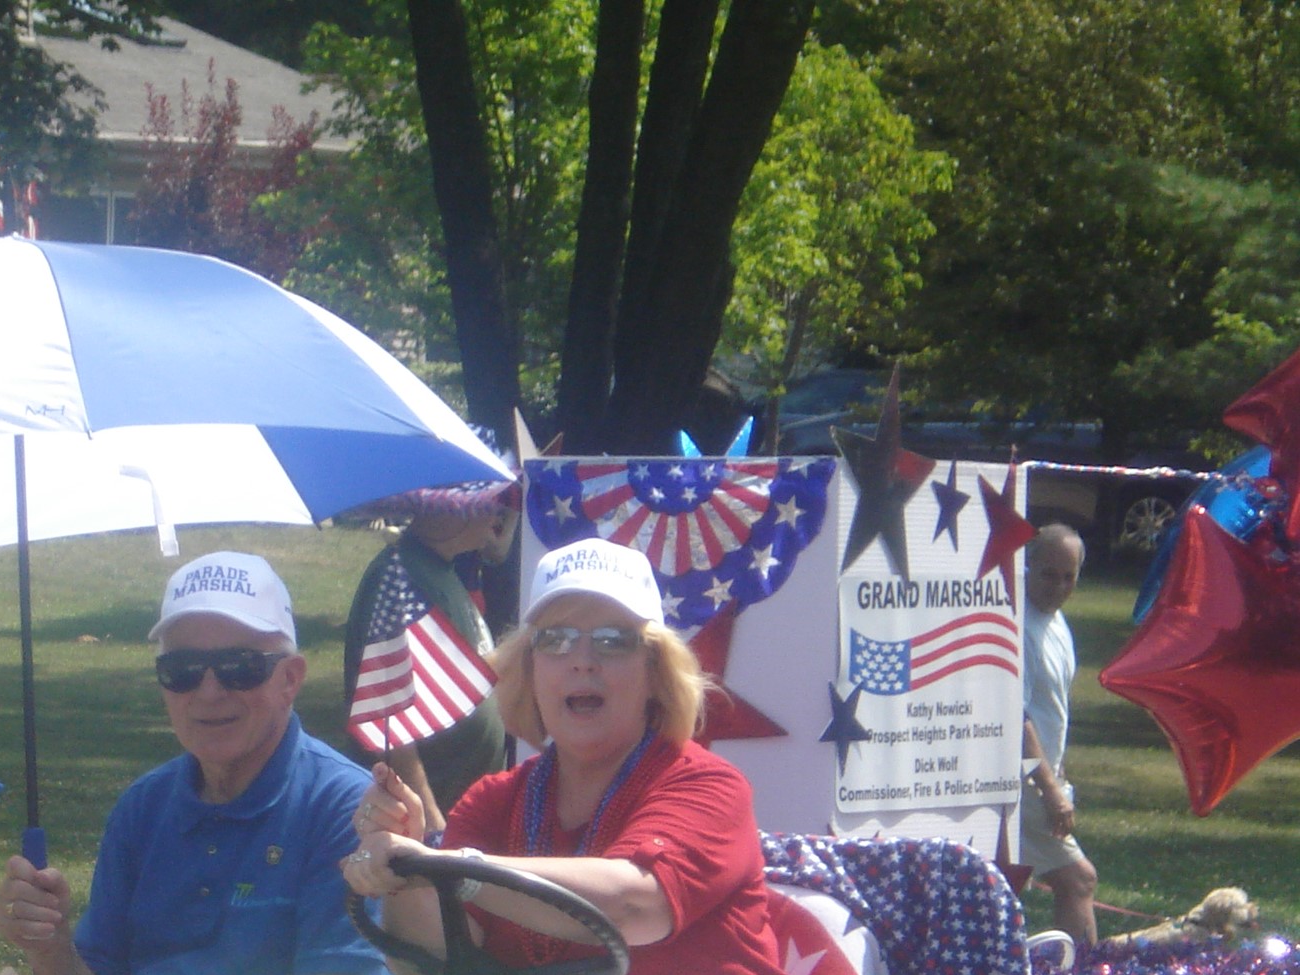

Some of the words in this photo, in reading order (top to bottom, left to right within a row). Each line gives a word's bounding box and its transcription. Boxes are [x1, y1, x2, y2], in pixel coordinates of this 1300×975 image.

[184, 565, 249, 585] PARADE
[173, 578, 256, 601] MARSHAL
[857, 580, 919, 610] GRAND
[906, 702, 934, 721] Kathy
[936, 700, 973, 717] Nowicki
[912, 727, 946, 745] Heights
[950, 725, 971, 740] Park
[973, 723, 1003, 738] District
[914, 758, 935, 774] Dick
[938, 756, 959, 772] Wolf
[914, 782, 931, 798] Fire
[935, 781, 942, 796] &
[944, 780, 973, 795] Police
